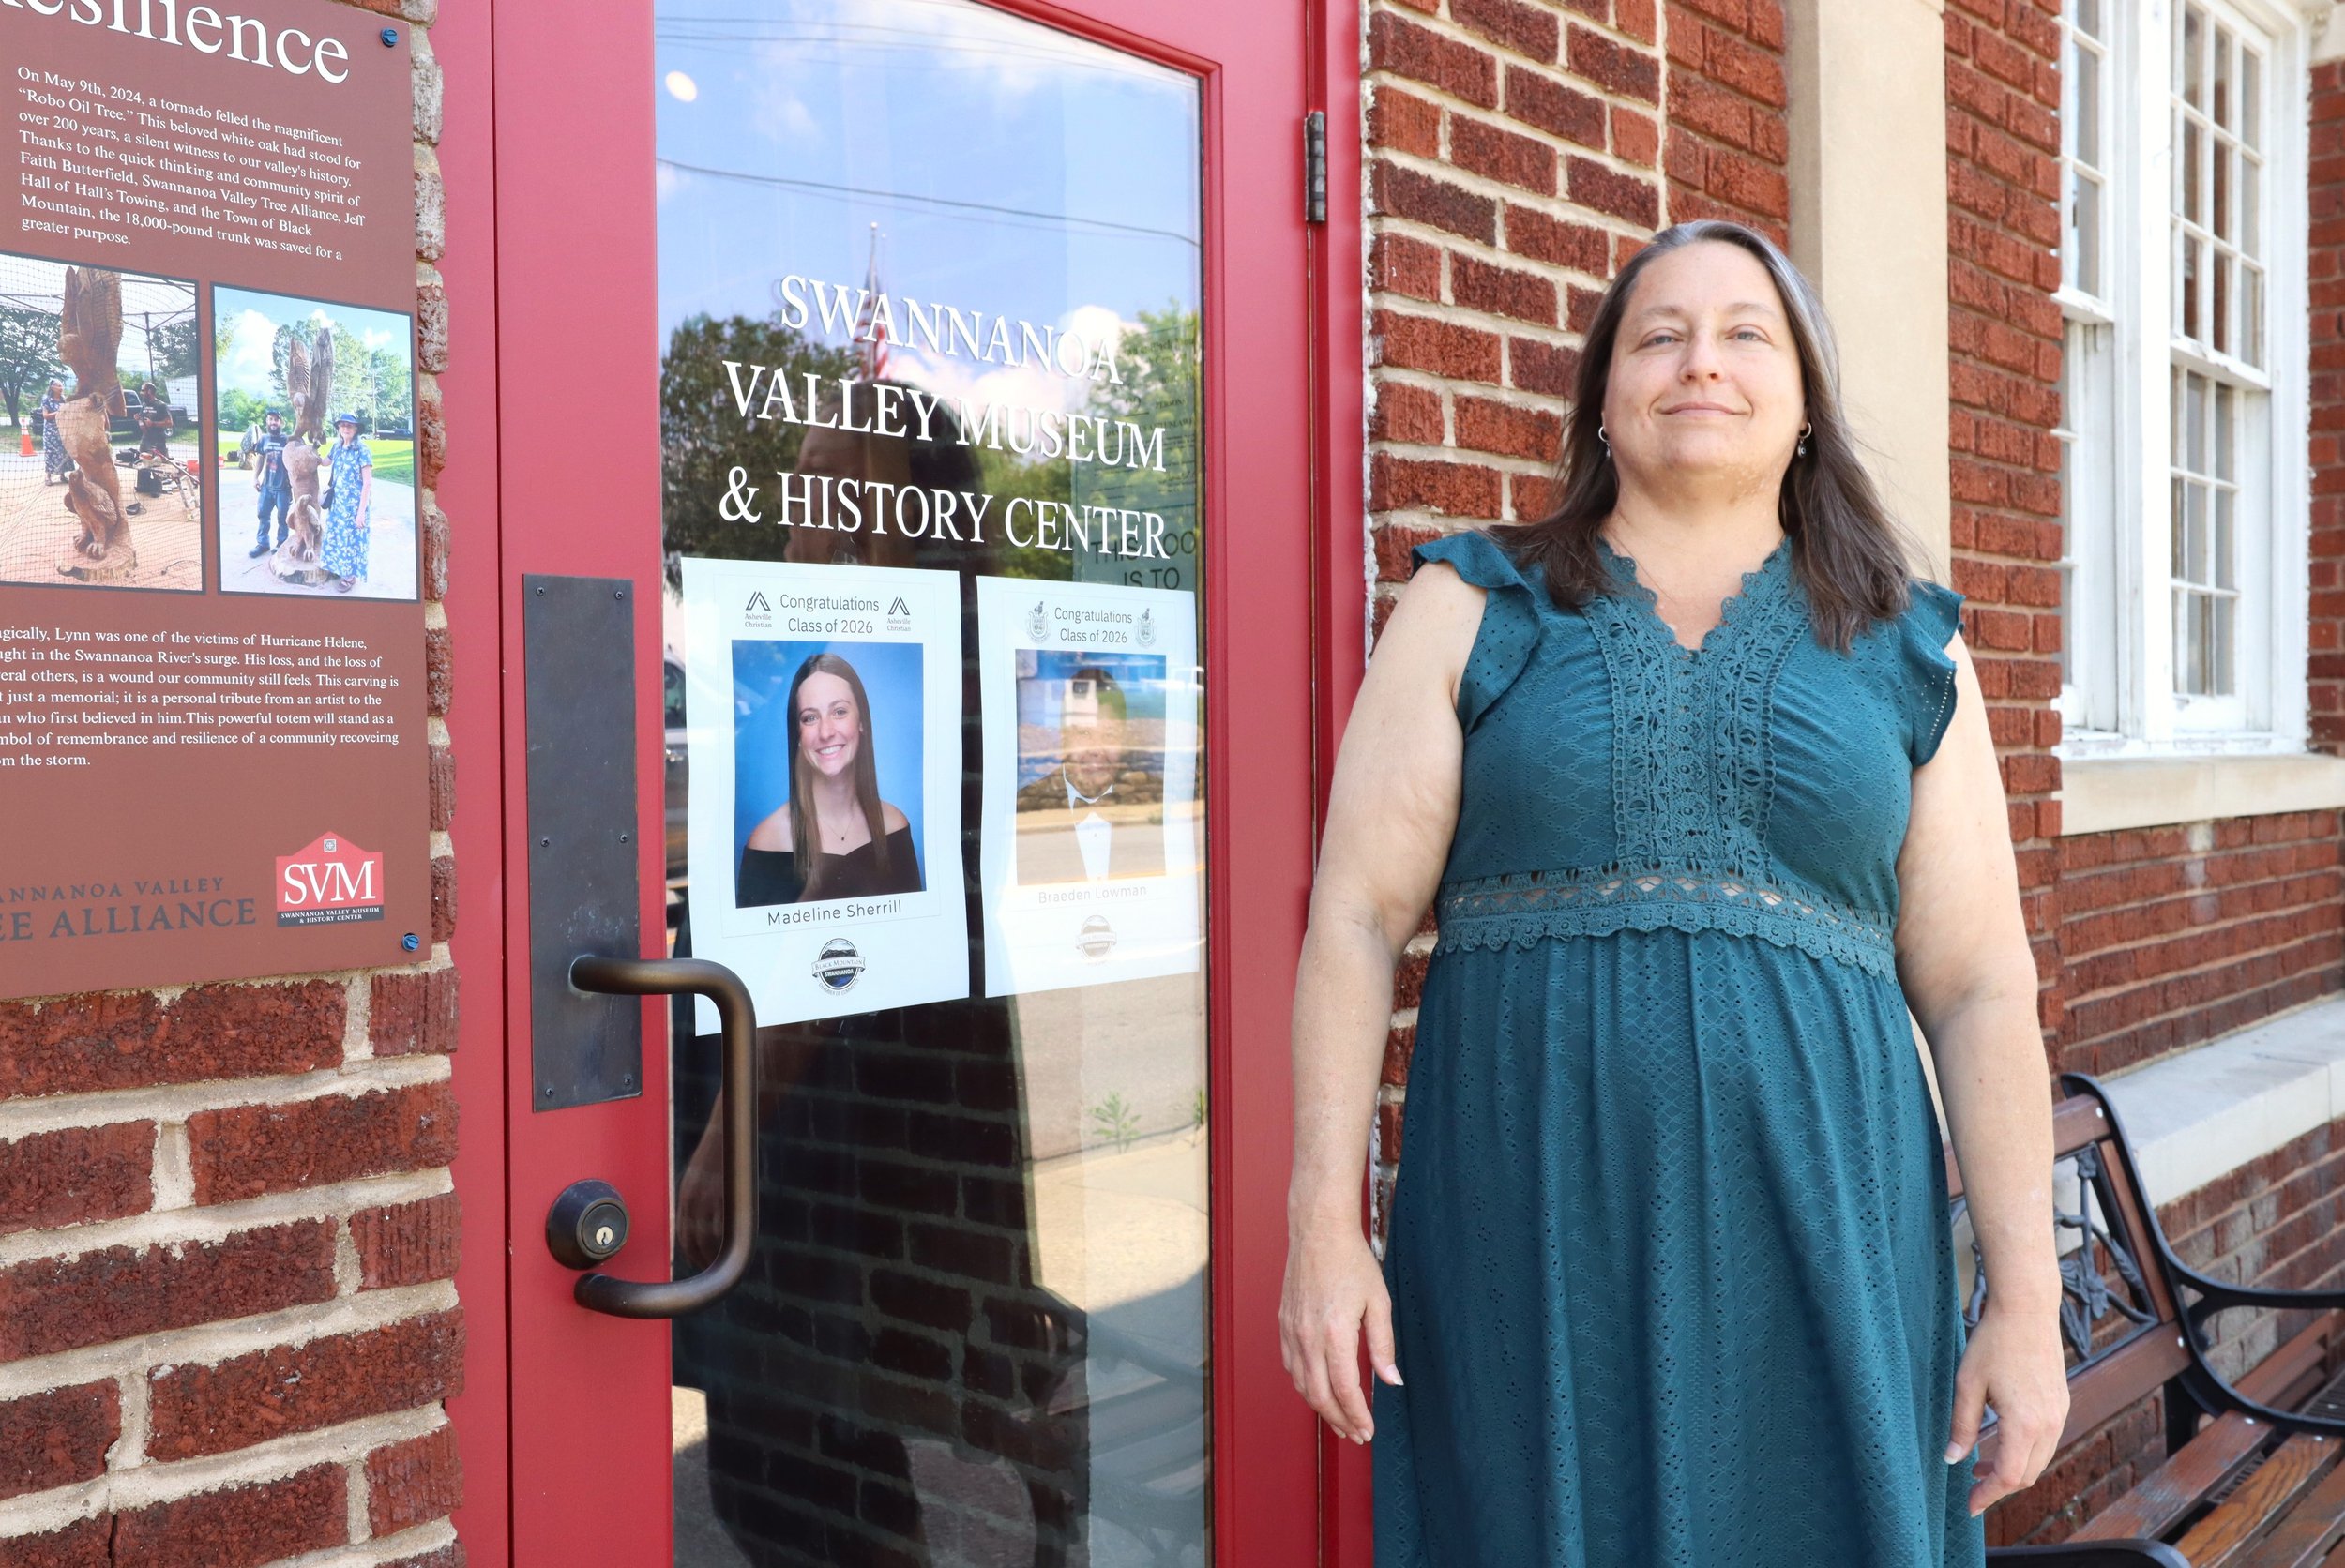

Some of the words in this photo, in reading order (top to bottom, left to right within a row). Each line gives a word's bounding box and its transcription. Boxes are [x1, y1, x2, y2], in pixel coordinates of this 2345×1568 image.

[18, 67, 39, 83] On
[44, 71, 76, 92] May
[79, 80, 106, 98] 9th,
[110, 86, 145, 106] 2024,
[149, 98, 157, 107] a
[160, 98, 212, 119] tornado
[216, 109, 249, 127] felled
[252, 117, 271, 131] the
[274, 125, 343, 147] magnificent
[68, 98, 90, 113] Oil
[136, 112, 166, 129] This
[170, 119, 218, 140] beloved
[221, 131, 255, 147] white
[258, 140, 280, 153] oak
[283, 143, 306, 158] had
[309, 151, 341, 165] stood
[344, 156, 361, 170] for
[19, 113, 50, 126] over
[53, 115, 78, 131] 200
[82, 124, 120, 142] years,
[124, 133, 131, 143] a
[135, 133, 170, 150] silent
[174, 142, 219, 160] witness
[223, 152, 236, 163] to
[239, 157, 262, 168] our
[309, 167, 351, 188] history.
[19, 129, 72, 152] Thanks
[76, 143, 90, 155] to
[94, 145, 115, 160] the
[119, 152, 156, 168] quick
[159, 158, 214, 182] thinking
[217, 172, 240, 184] and
[243, 177, 311, 200] community
[314, 189, 344, 204] spirit
[347, 195, 361, 206] of
[21, 151, 57, 170] Faith
[62, 158, 138, 186] Butterfield,
[142, 174, 217, 200] Swannanoa
[219, 188, 257, 209] Valley
[260, 196, 287, 212] Tree
[290, 203, 341, 223] Alliance,
[344, 212, 366, 226] Jeff
[21, 173, 51, 189] Hall
[54, 180, 70, 192] of
[116, 189, 169, 213] Towing,
[173, 204, 197, 216] and
[201, 205, 220, 219] the
[223, 209, 258, 226] Town
[261, 218, 276, 229] of
[279, 219, 312, 236] Black
[21, 193, 96, 219] Mountain,
[99, 208, 120, 222] the
[126, 212, 213, 238] 18,000-pound
[217, 230, 250, 245] trunk
[254, 237, 278, 249] was
[280, 242, 312, 255] saved
[315, 245, 333, 258] for
[336, 251, 342, 261] a
[22, 219, 70, 234] greater
[74, 227, 130, 245] purpose.
[781, 275, 1124, 385] SWANNANOA
[722, 360, 944, 441] VALLEY
[956, 397, 1166, 472] MUSEUM
[719, 466, 761, 523] &
[777, 471, 993, 543] HISTORY
[1005, 497, 1171, 559] CENTER
[1150, 566, 1180, 590] TO
[780, 594, 880, 612] Congratulations
[744, 612, 772, 621] Asheville
[788, 617, 822, 633] Class
[825, 618, 838, 633] of
[841, 619, 873, 634] 2026
[1054, 607, 1133, 624] Congratulations
[55, 627, 91, 643] Lynn
[95, 632, 120, 641] was
[124, 633, 148, 642] one
[152, 631, 167, 642] of
[171, 631, 191, 643] the
[194, 632, 239, 645] victims
[242, 634, 257, 645] of
[261, 634, 321, 647] Hurricane
[325, 636, 367, 650] Helene,
[1060, 628, 1087, 642] Class
[1089, 629, 1100, 642] of
[1102, 630, 1127, 643] 2026
[32, 648, 45, 660] in
[50, 648, 70, 661] the
[75, 649, 153, 663] Swannanoa
[204, 656, 240, 667] surge.
[245, 654, 265, 665] His
[269, 654, 295, 667] loss,
[297, 655, 320, 666] and
[324, 656, 341, 667] the
[345, 656, 367, 668] loss
[369, 656, 383, 668] of
[0, 669, 26, 681] eral
[31, 670, 78, 684] others,
[83, 670, 93, 682] is
[97, 673, 104, 683] a
[109, 671, 154, 683] wound
[158, 674, 181, 684] our
[184, 672, 255, 687] community
[259, 673, 280, 685] still
[284, 673, 312, 686] feels.
[315, 674, 341, 686] This
[344, 675, 387, 689] carving
[390, 675, 399, 686] is
[37, 732, 53, 745] of
[57, 732, 148, 745] remembrance
[152, 732, 176, 744] and
[181, 731, 238, 744] resilience
[241, 731, 256, 744] of
[259, 735, 266, 744] a
[269, 731, 337, 746] community
[340, 731, 399, 746] recoveirng
[20, 754, 42, 766] the
[46, 755, 90, 765] storm.
[133, 877, 224, 896] VALLEY
[284, 860, 376, 905] SVM
[1038, 889, 1091, 904] Braeden
[1096, 886, 1147, 899] Lowman
[0, 912, 34, 941] E
[49, 897, 257, 939] ALLIANCE
[280, 910, 325, 919] SWANNANOA
[326, 908, 351, 916] VALLEY
[352, 906, 380, 914] MUSEUM
[307, 915, 335, 924] HISTORY
[767, 907, 841, 926] Madeline
[847, 899, 902, 918] Sherrill
